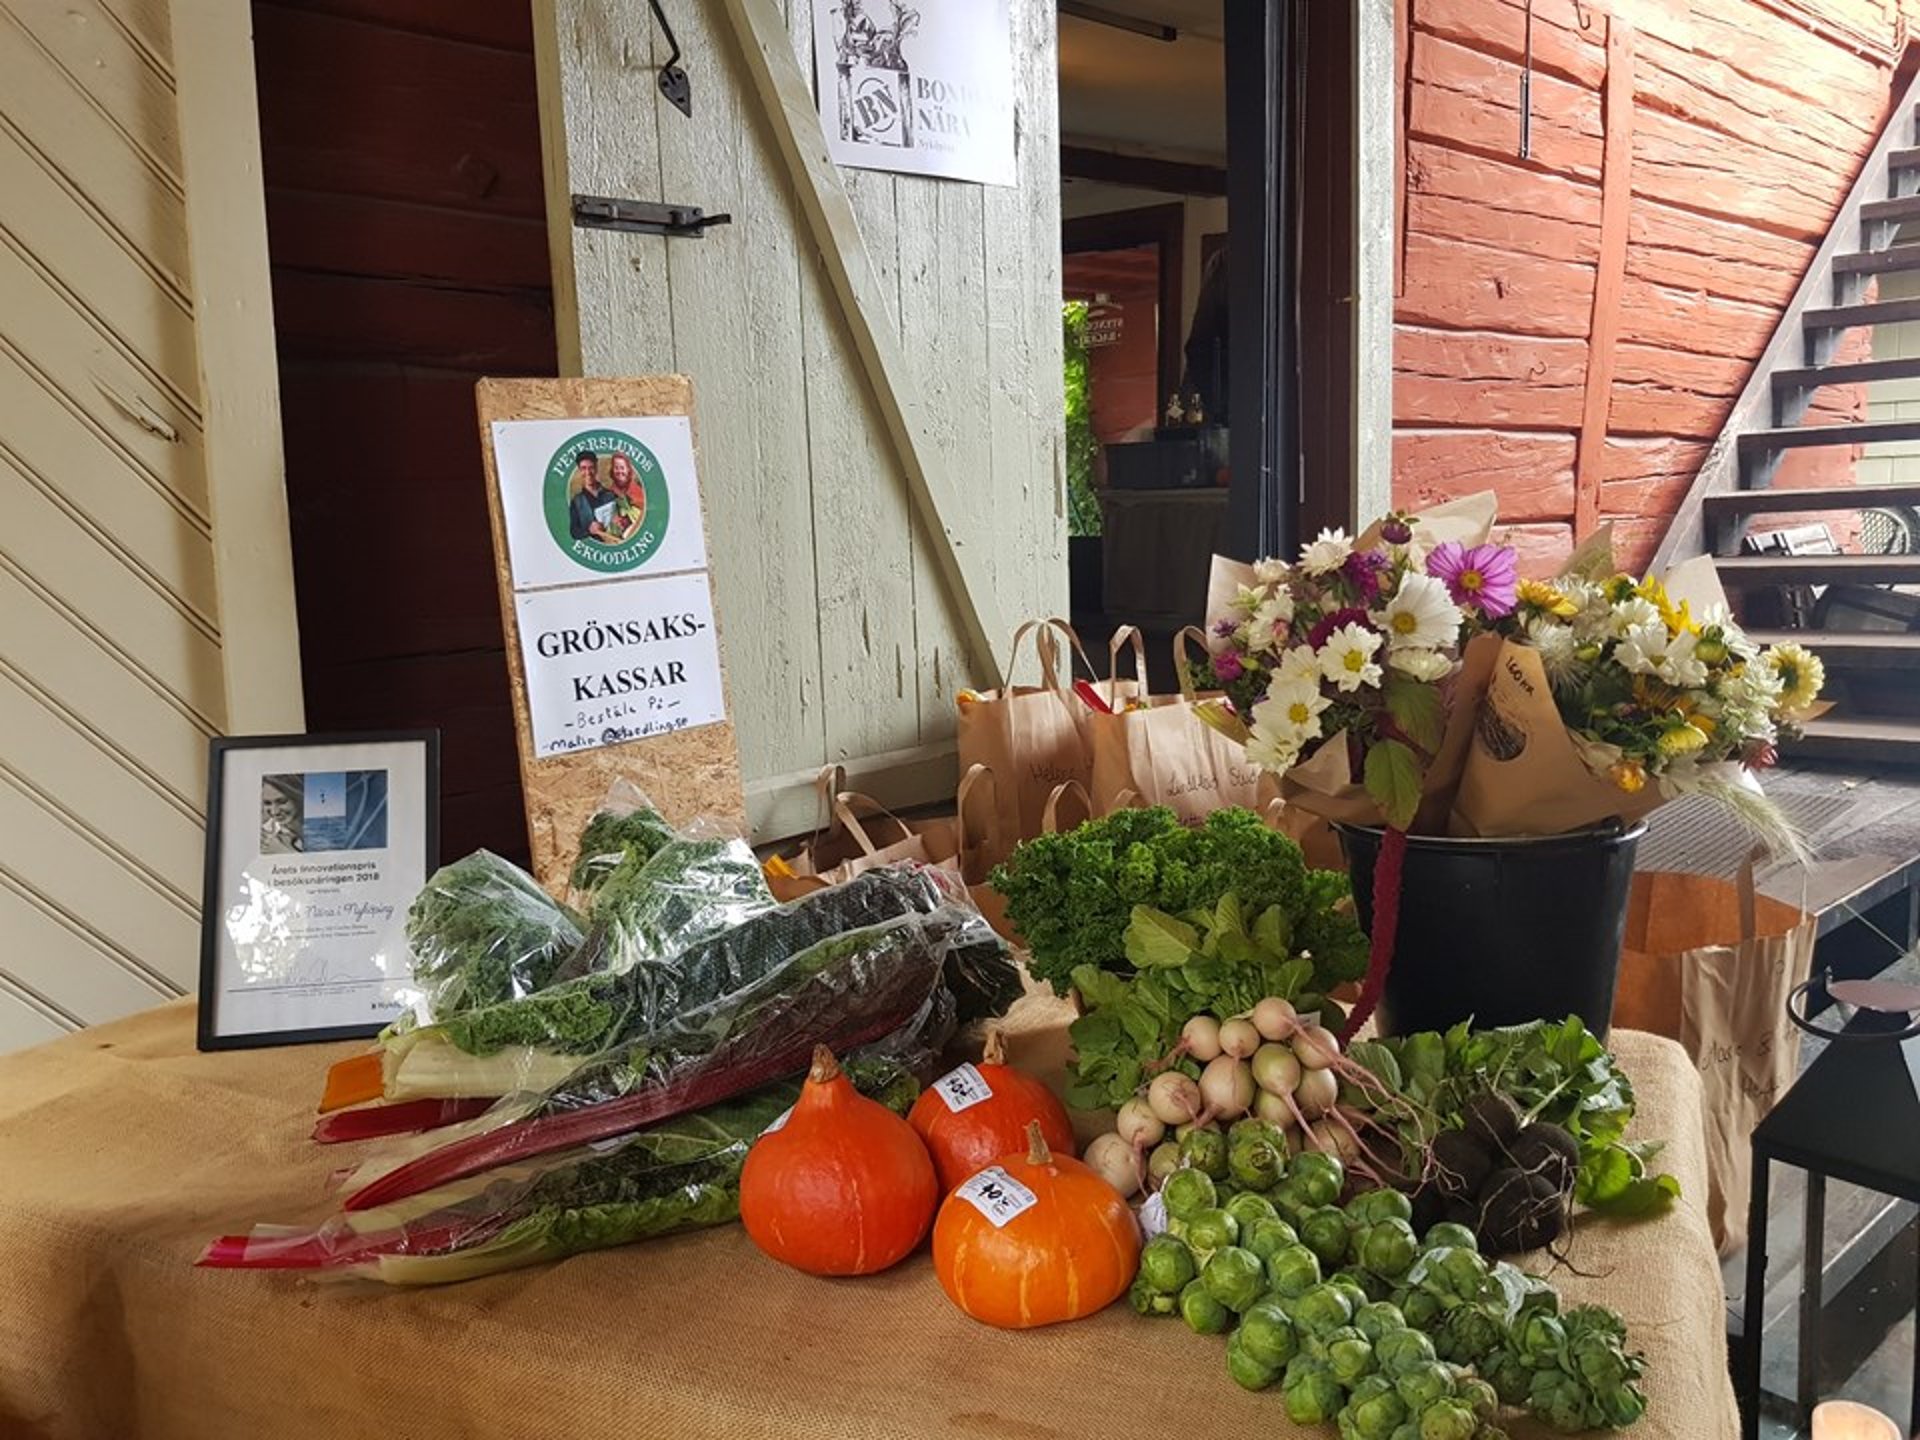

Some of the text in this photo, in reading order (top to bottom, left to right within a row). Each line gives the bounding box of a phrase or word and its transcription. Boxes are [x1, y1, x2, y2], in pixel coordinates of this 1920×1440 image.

[854, 84, 898, 129] BN
[553, 436, 654, 477] PETERSLUNDS
[572, 531, 655, 565] EKOODLING
[537, 613, 706, 658] GRÖNSAKS-
[572, 661, 688, 701] KASSAR
[356, 872, 379, 882] 2018
